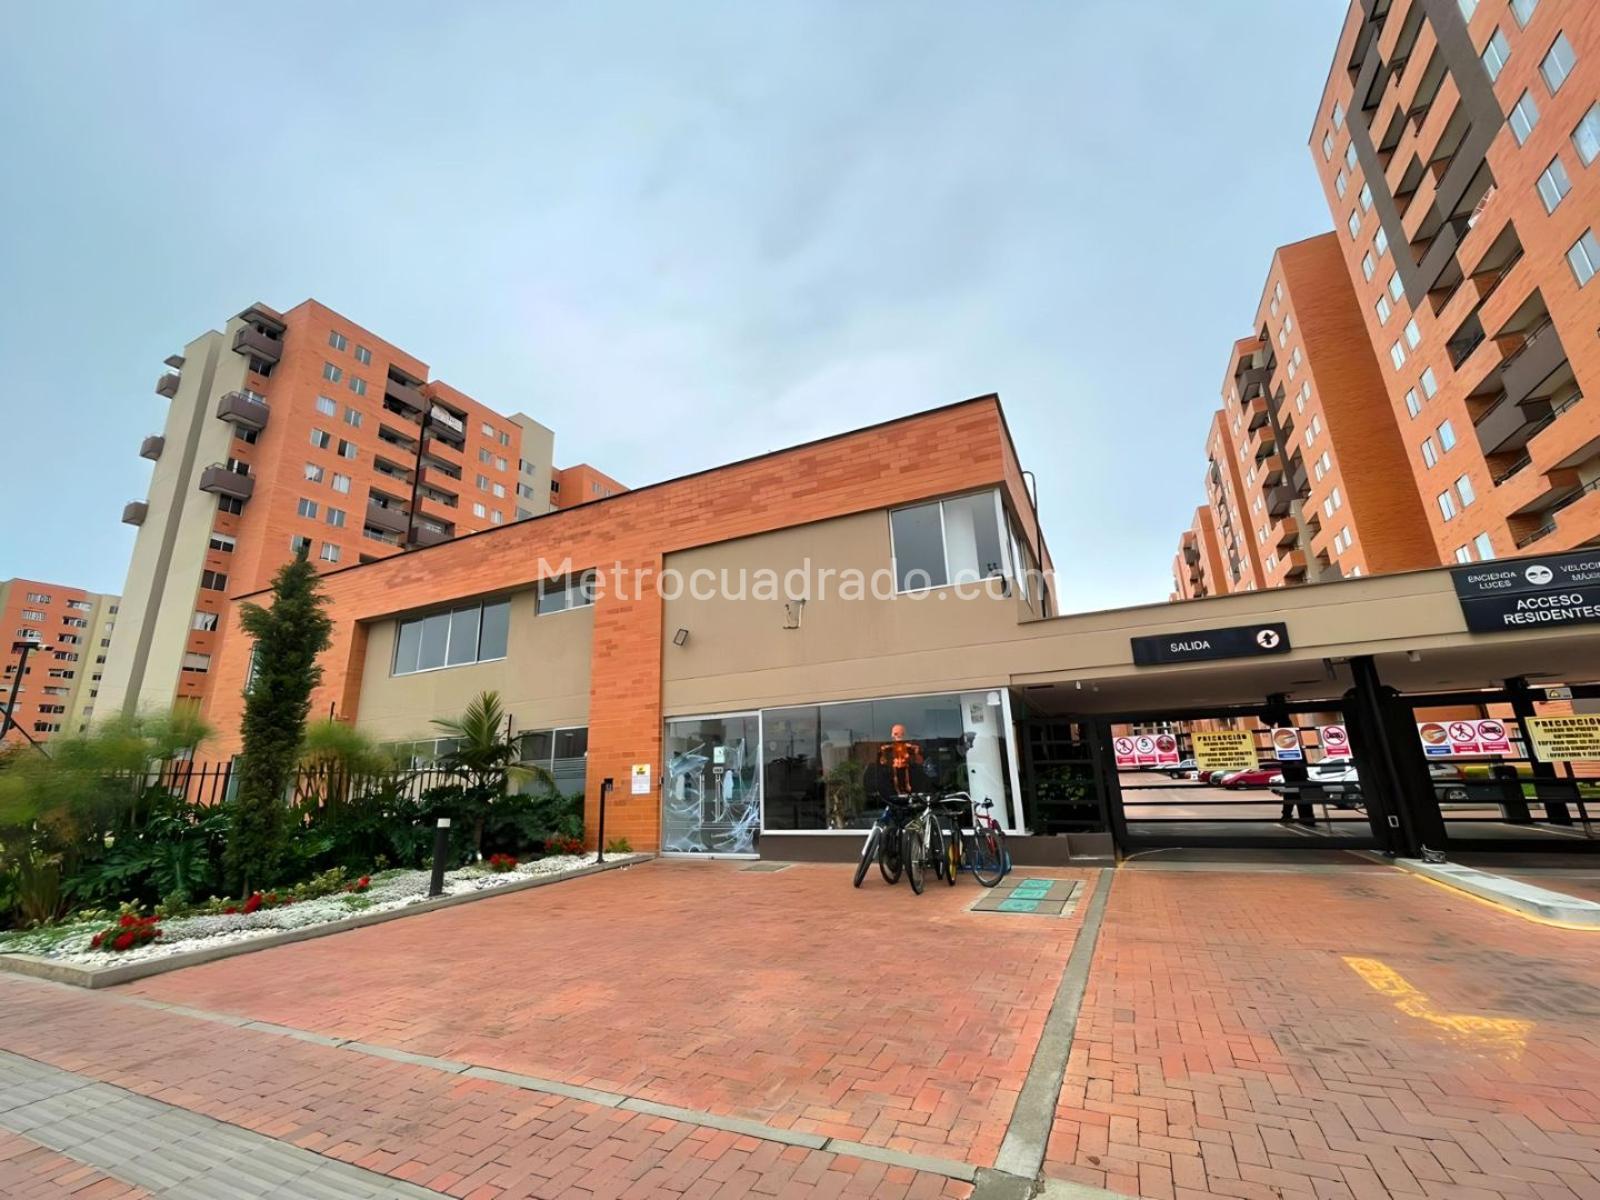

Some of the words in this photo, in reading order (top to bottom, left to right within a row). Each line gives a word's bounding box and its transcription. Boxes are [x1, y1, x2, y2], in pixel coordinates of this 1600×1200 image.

[1467, 571, 1518, 583] ENCIENDA
[1479, 579, 1512, 590] LUCES
[1516, 593, 1583, 611] ACCESO
[1503, 605, 1600, 625] RESIDENTES
[1170, 640, 1211, 653] SALIDA
